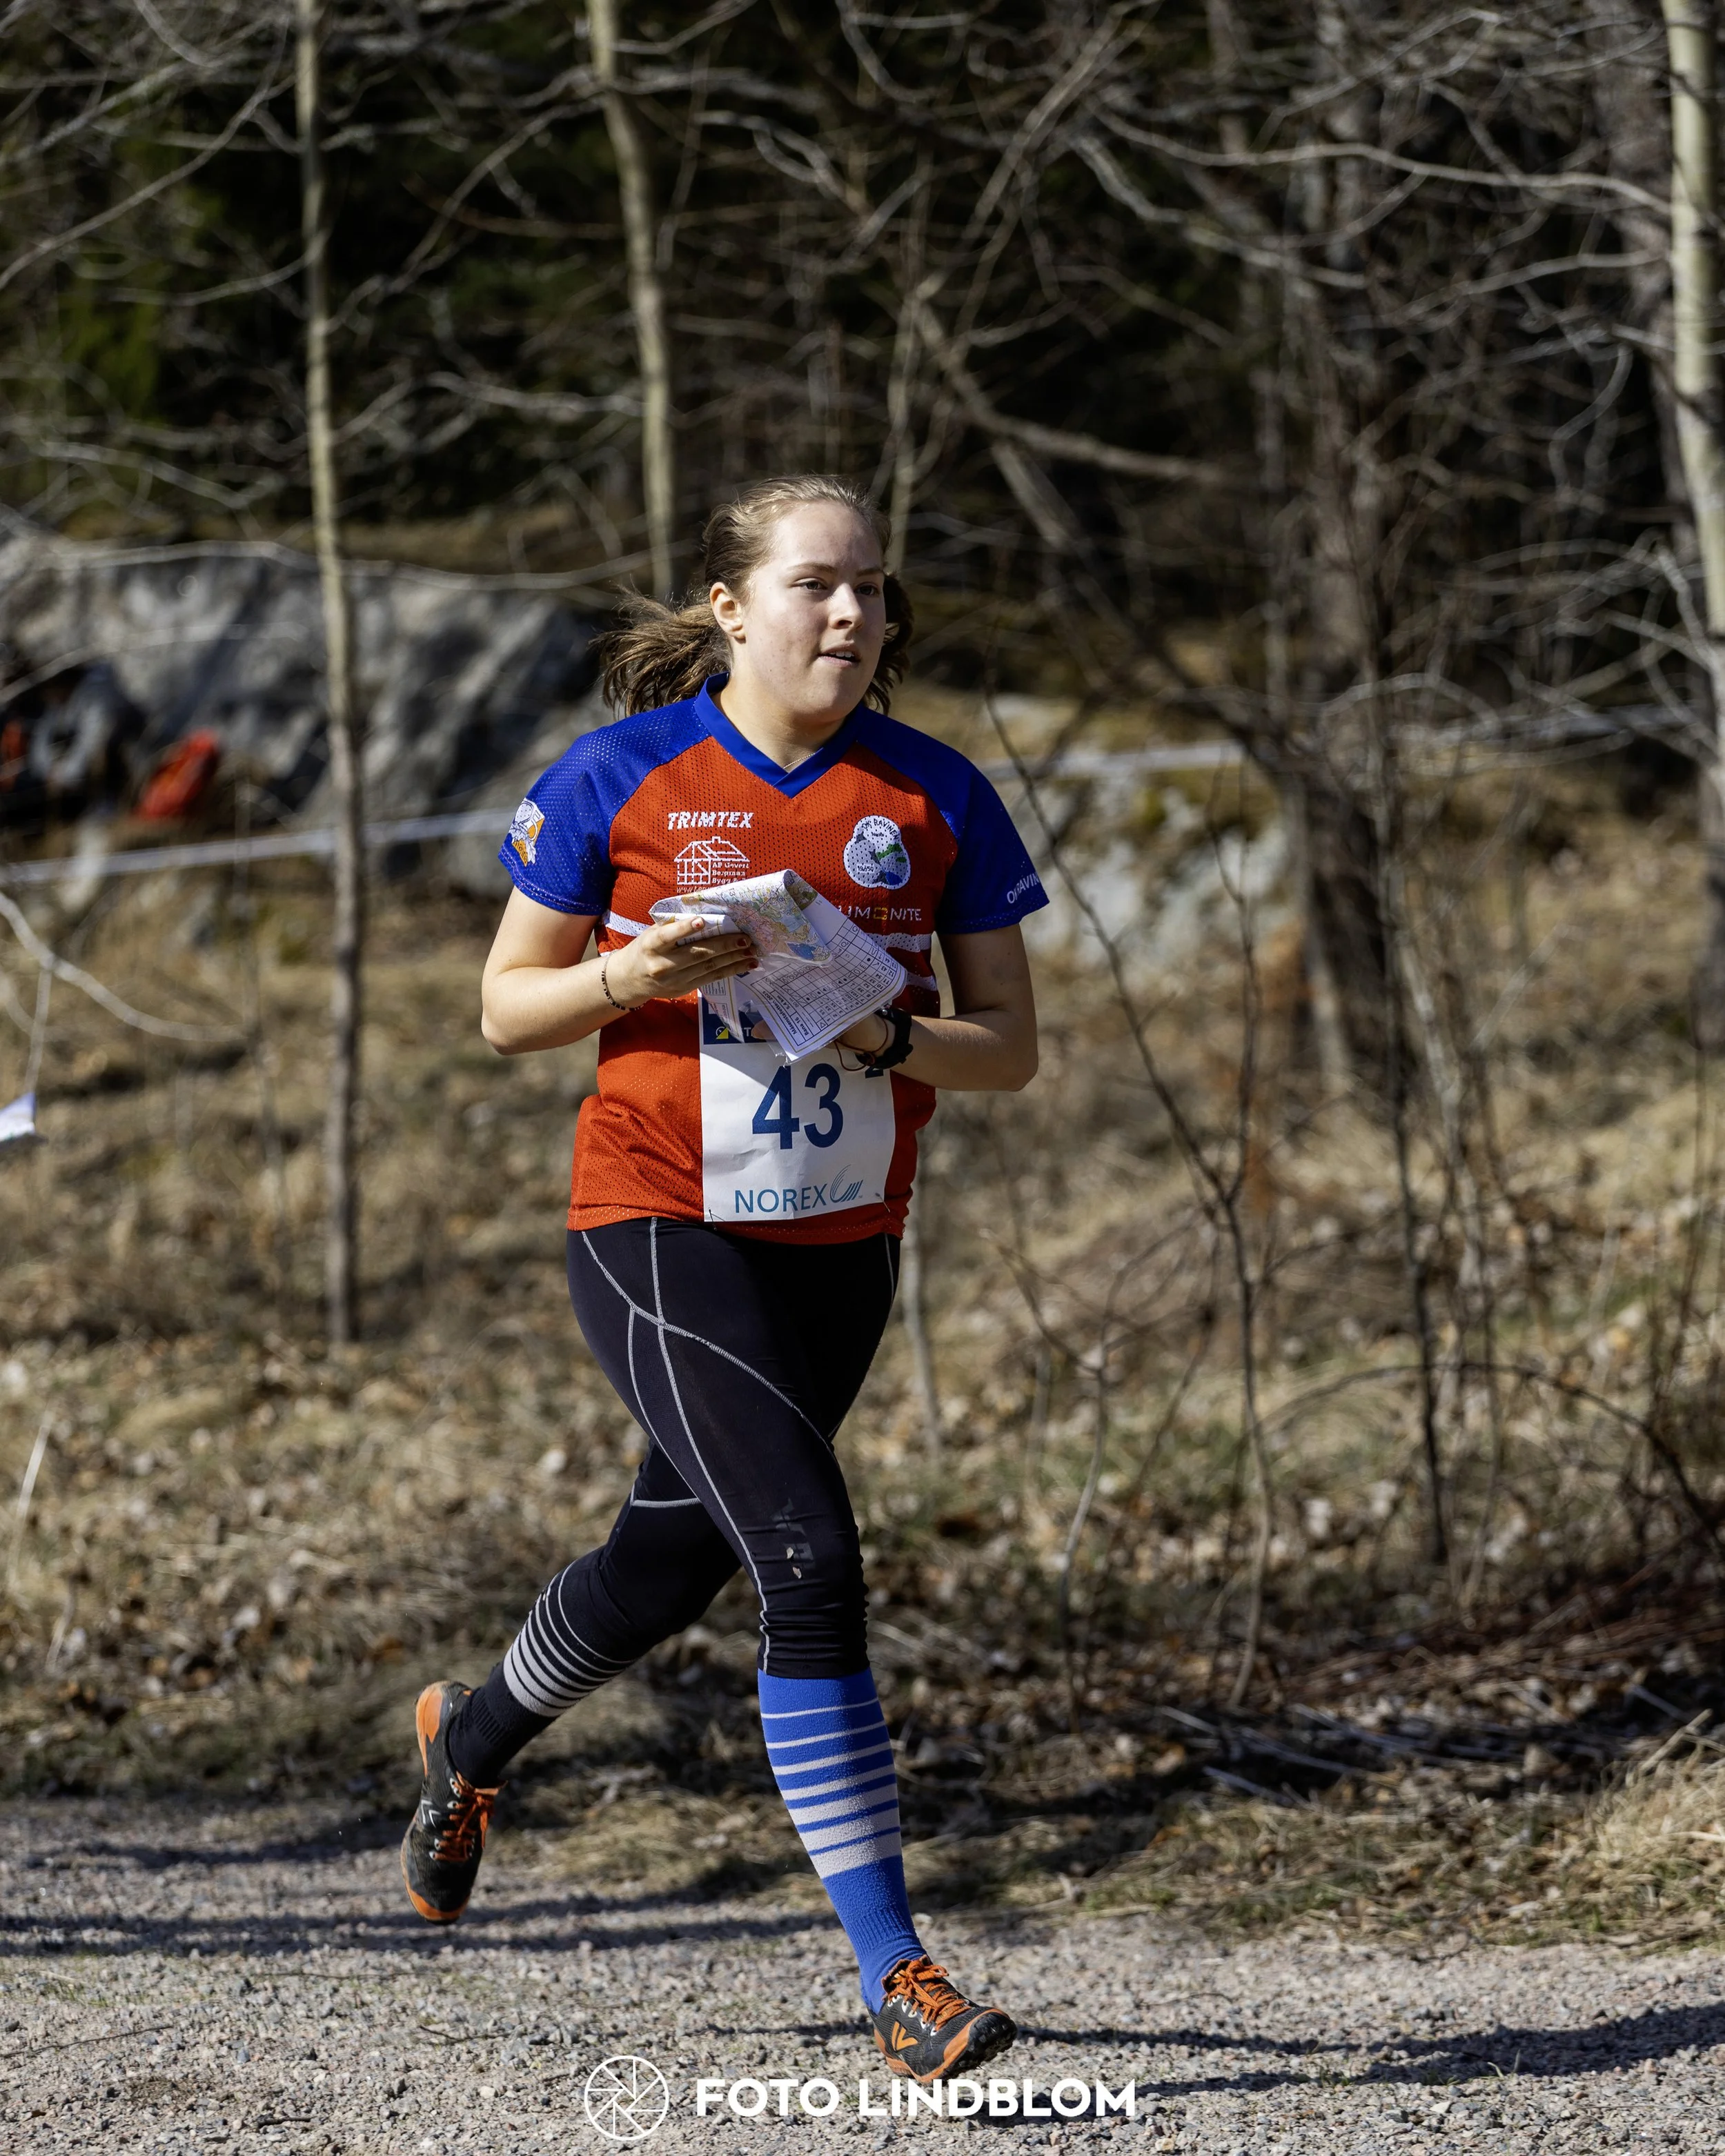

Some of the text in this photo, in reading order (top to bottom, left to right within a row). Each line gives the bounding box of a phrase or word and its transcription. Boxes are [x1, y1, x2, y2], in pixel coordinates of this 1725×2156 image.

[667, 811, 754, 830] TRIMTEX
[874, 818, 899, 840] RAVINEN
[838, 905, 922, 920] UMONITE
[773, 1000, 797, 1034] Måsenstafetten
[800, 1023, 809, 1036] Bana
[752, 1063, 843, 1149] 43
[735, 1183, 827, 1213] NOREX
